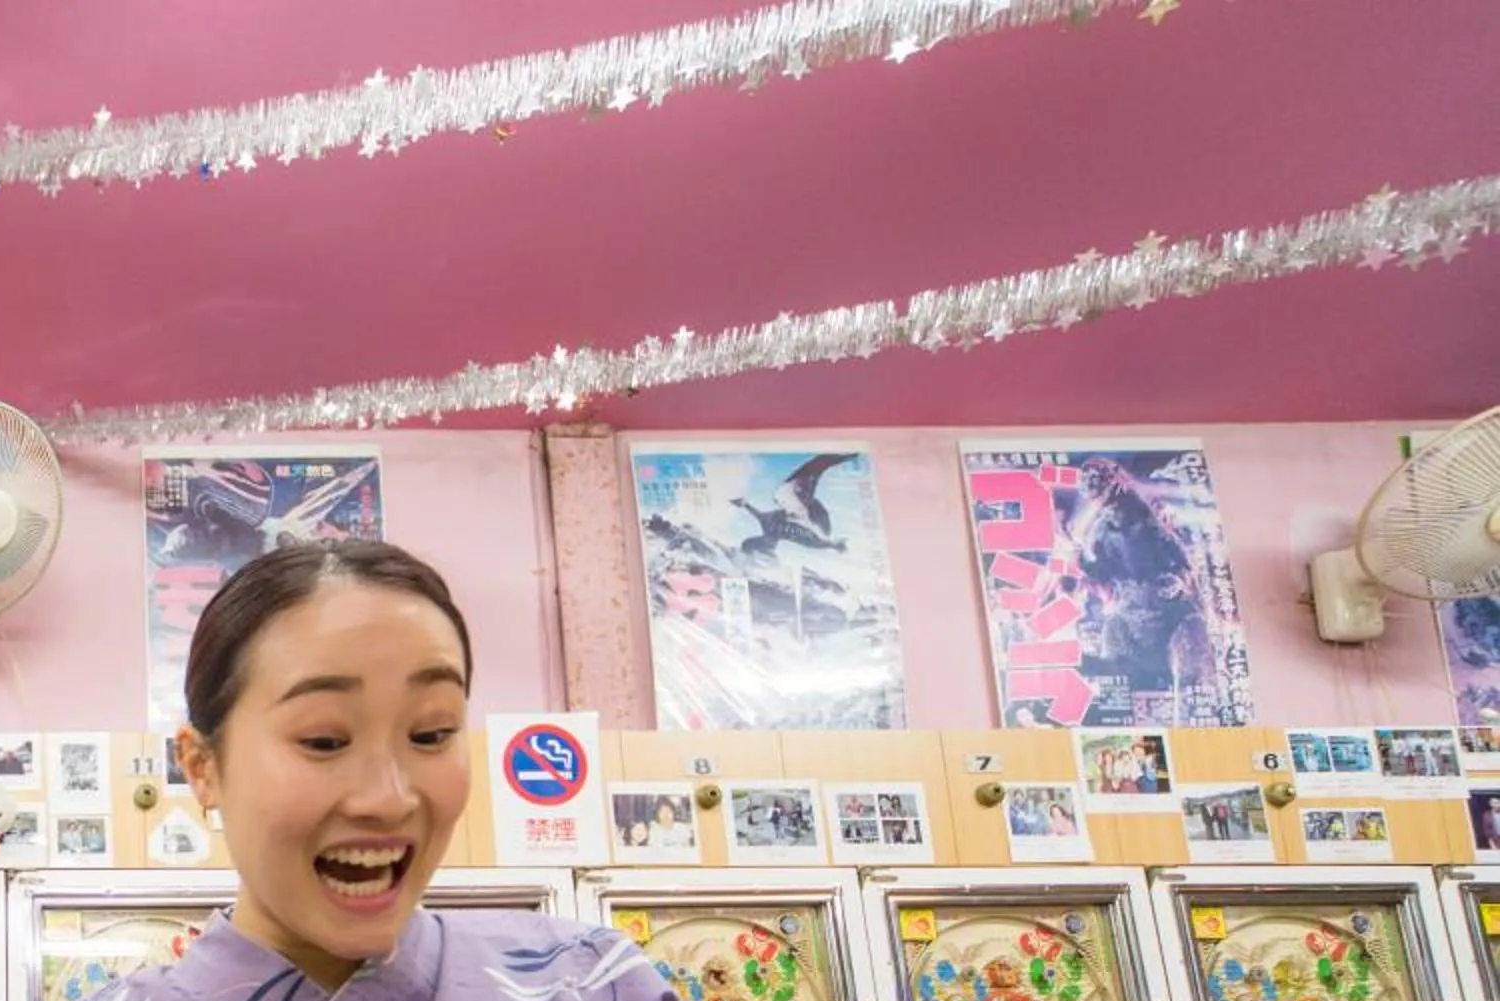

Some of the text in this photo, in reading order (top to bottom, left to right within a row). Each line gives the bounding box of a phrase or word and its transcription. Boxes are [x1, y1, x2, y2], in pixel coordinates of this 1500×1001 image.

[133, 758, 154, 775] 11
[975, 755, 991, 771] 7
[1263, 753, 1279, 770] 6
